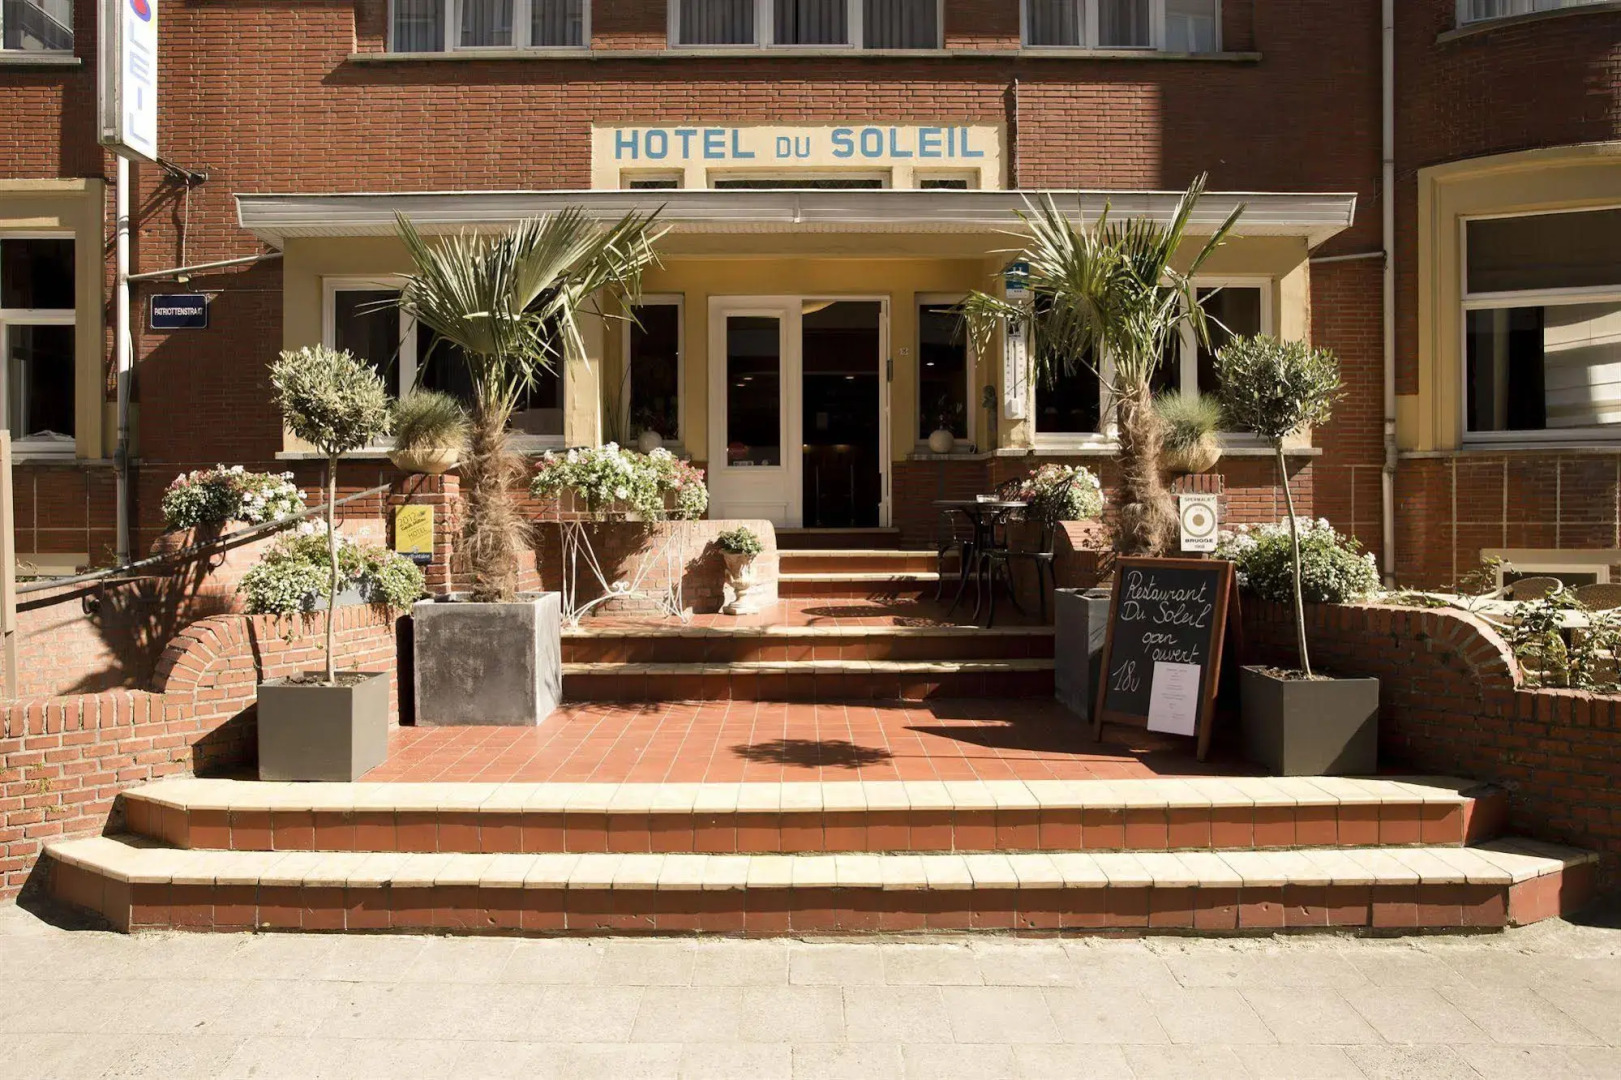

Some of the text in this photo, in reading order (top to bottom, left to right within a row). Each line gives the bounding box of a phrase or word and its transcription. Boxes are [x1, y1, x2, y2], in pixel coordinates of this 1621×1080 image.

[615, 126, 985, 160] HOTEL DU SOLEIL
[154, 307, 204, 316] PATRIOTTENSTRAAT
[1126, 570, 1206, 602] Restaurant
[1121, 600, 1212, 628] Du Soleil
[1142, 631, 1177, 653] open
[1152, 643, 1199, 665] ouvert
